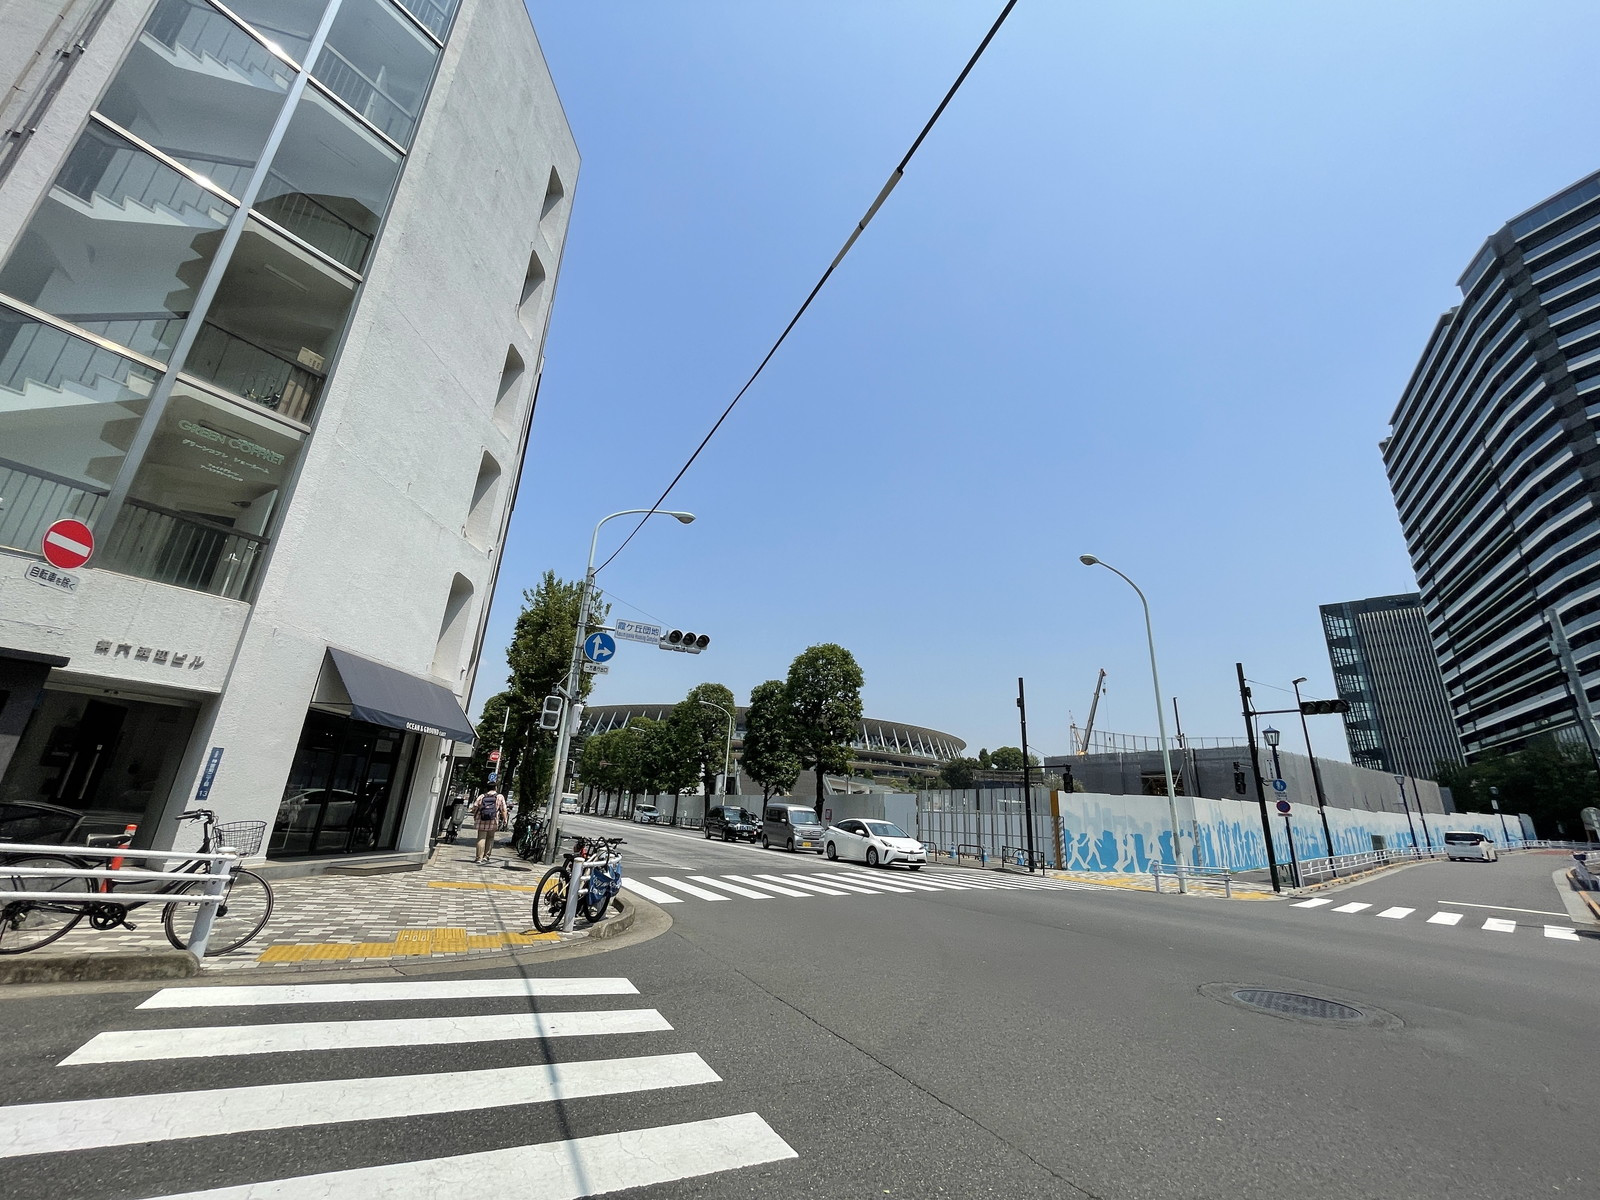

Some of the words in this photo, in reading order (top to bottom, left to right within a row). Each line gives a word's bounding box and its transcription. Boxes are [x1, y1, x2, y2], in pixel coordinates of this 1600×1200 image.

[179, 420, 227, 444] GREEN
[30, 566, 75, 591] 自転車を除く
[406, 721, 420, 732] OCEAN
[424, 726, 440, 736] GROUND
